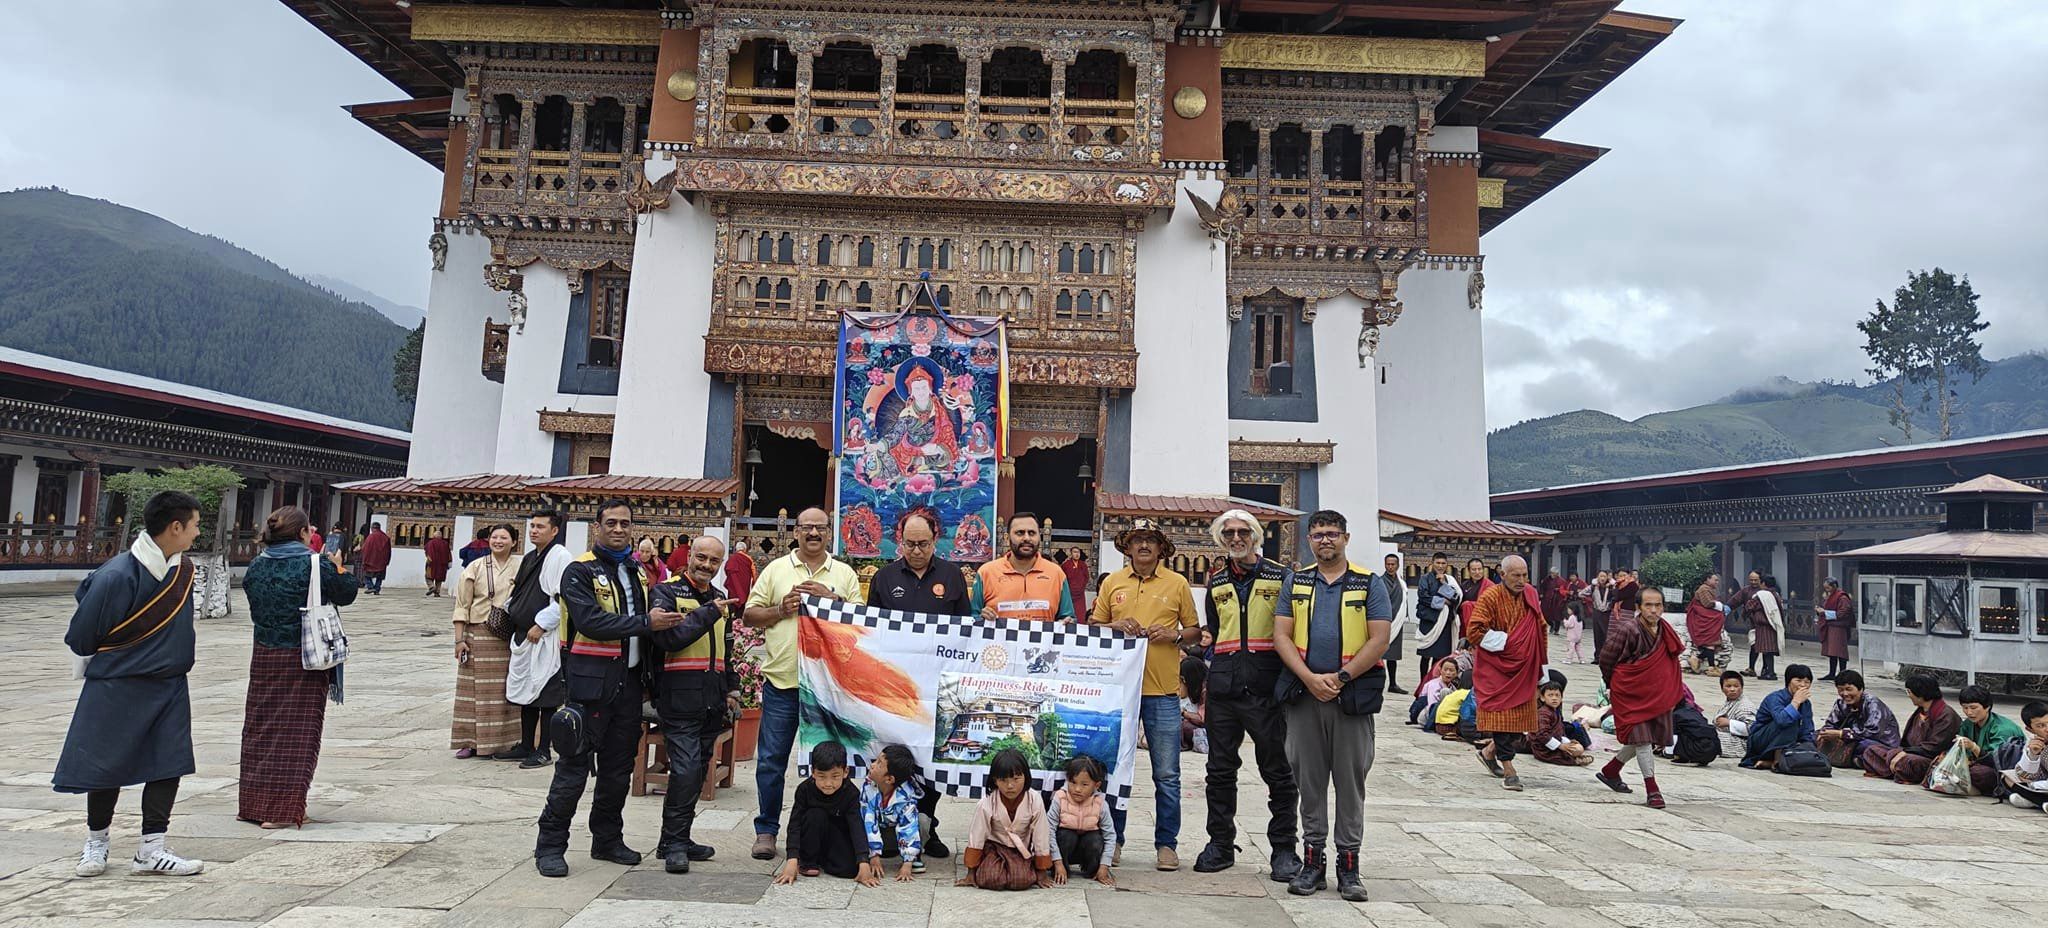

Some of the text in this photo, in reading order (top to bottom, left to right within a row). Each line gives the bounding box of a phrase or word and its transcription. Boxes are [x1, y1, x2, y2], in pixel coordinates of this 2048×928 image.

[936, 645, 979, 663] Rotary
[960, 676, 1019, 690] Happiness
[1023, 681, 1048, 692] Ride
[1060, 684, 1102, 696] Bhutan
